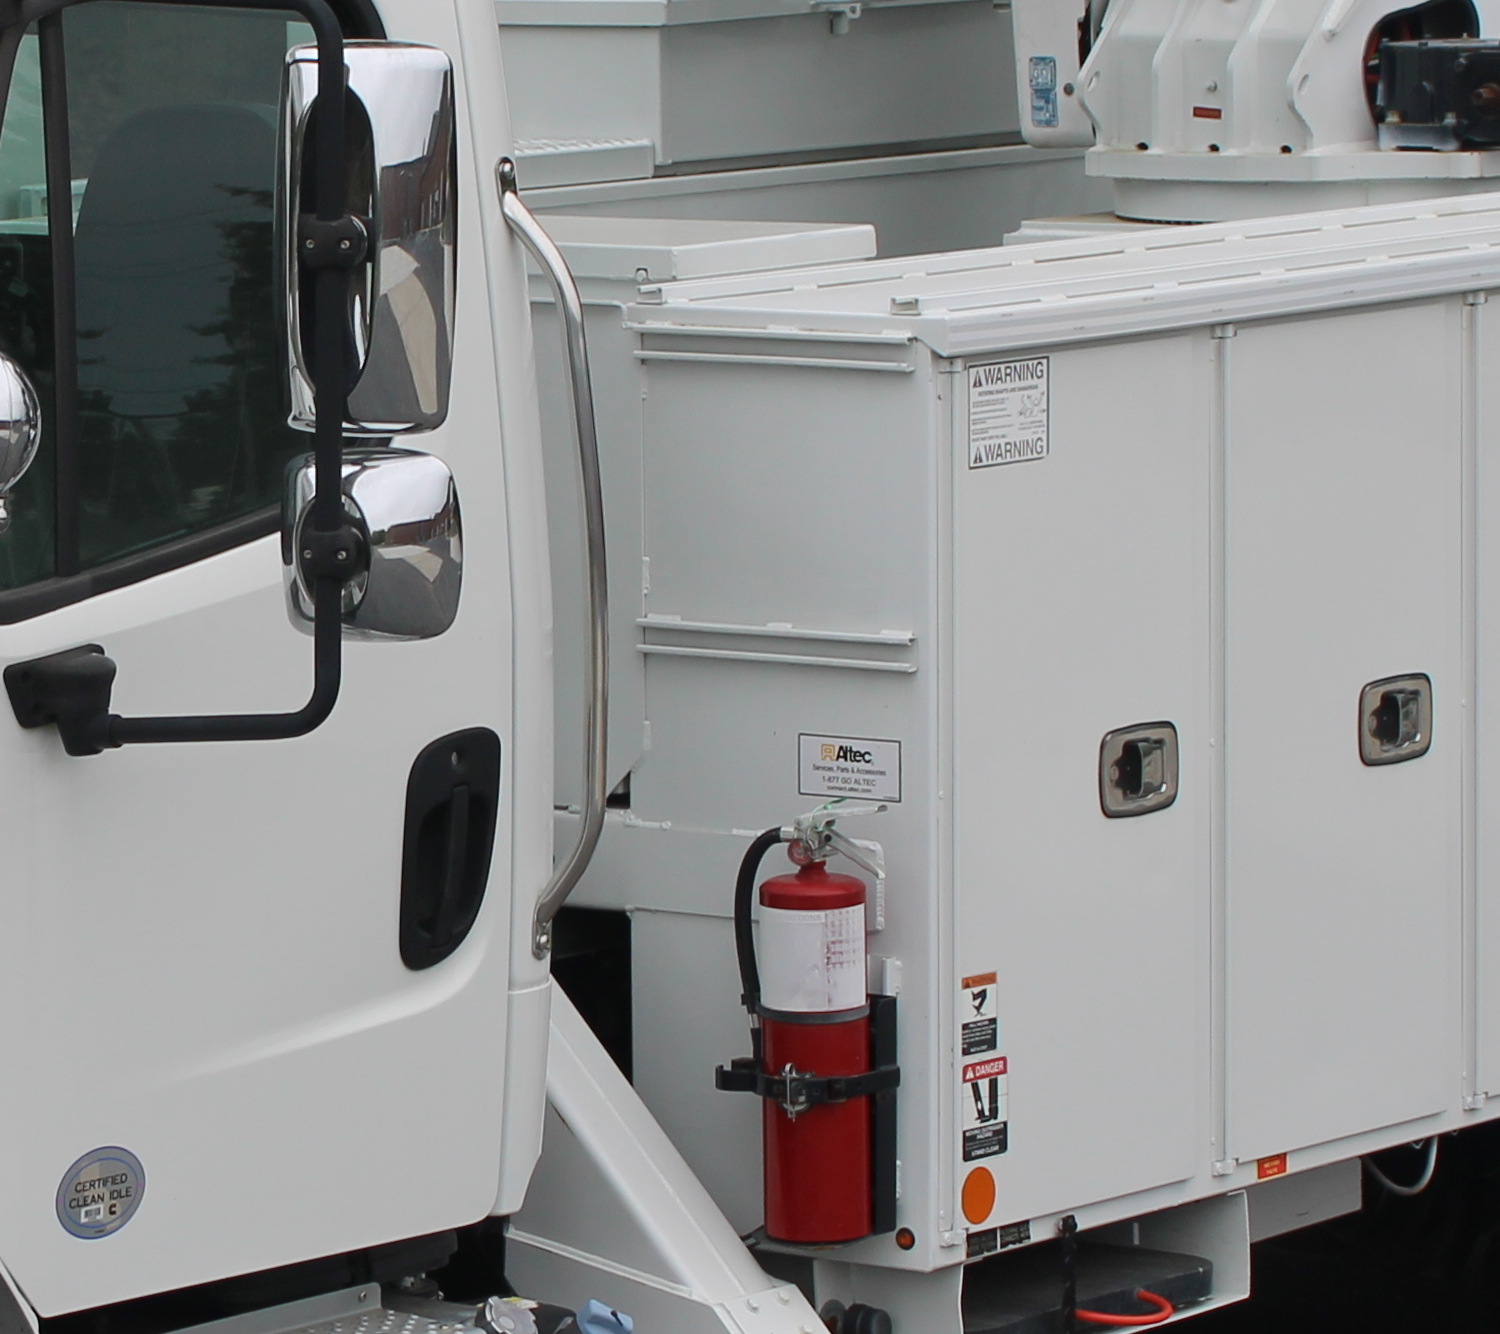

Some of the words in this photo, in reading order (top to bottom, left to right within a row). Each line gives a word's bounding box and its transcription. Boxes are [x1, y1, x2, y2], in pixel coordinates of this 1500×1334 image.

[984, 362, 1044, 385] WARNING
[984, 438, 1044, 463] WARNING
[836, 745, 872, 763] Altec
[841, 777, 852, 785] GO
[853, 778, 877, 787] ALTEC
[975, 1060, 1004, 1077] DANGER
[74, 1173, 128, 1194] CERTIFIED
[68, 1192, 105, 1210] CLEAN
[109, 1186, 133, 1201] IDLE
